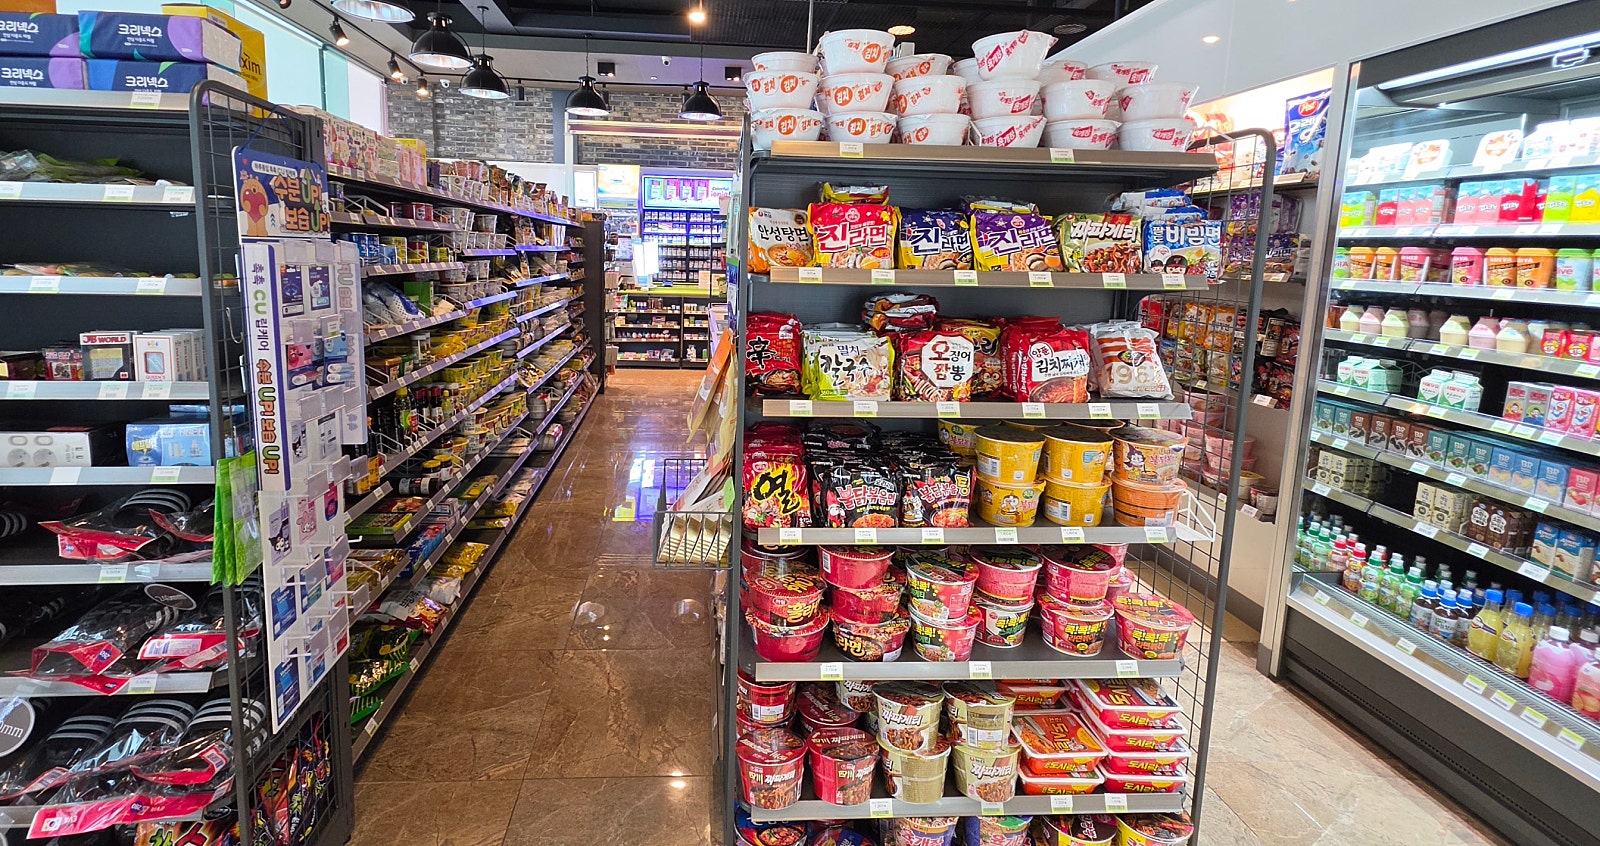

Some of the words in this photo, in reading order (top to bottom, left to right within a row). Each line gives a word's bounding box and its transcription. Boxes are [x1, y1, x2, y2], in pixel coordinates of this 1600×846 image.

[118, 24, 162, 37] 크리넥스
[1, 67, 44, 80] 크리넥스
[125, 76, 168, 88] 크리넥스
[780, 117, 795, 133] 김치
[274, 175, 301, 203] 수분
[301, 168, 323, 205] UP!
[285, 206, 310, 231] 보습
[758, 224, 809, 242] 안성탕면
[817, 222, 888, 253] 진라면
[911, 227, 971, 255] 진라면
[1071, 219, 1138, 242] 짜파게티
[1152, 227, 1166, 244] 팔도
[1166, 225, 1221, 246] 비빔면
[252, 262, 266, 286] 촉촉
[253, 289, 268, 315] CU
[83, 335, 97, 344] JB
[255, 318, 270, 351] 립케어
[747, 336, 776, 369] 辛
[837, 345, 861, 357] 멸치
[929, 340, 972, 363] 오징어
[1031, 348, 1050, 358] 양푼
[256, 359, 273, 385] 수분
[820, 353, 872, 387] 칼국수
[933, 362, 966, 381] 짬뽕
[257, 387, 277, 417] UP!
[260, 418, 277, 444] 보습
[262, 445, 281, 475] UP!
[752, 469, 801, 515] 열
[836, 483, 897, 511] 불닭볶음면
[881, 708, 923, 726] 짜파게티
[1119, 713, 1150, 726] 도시락
[1051, 722, 1069, 751] 도시락
[1126, 737, 1156, 749] 도시락
[764, 769, 797, 786] 짜파게티
[970, 763, 1013, 779] 짜파게티
[1128, 760, 1159, 772] 도시락
